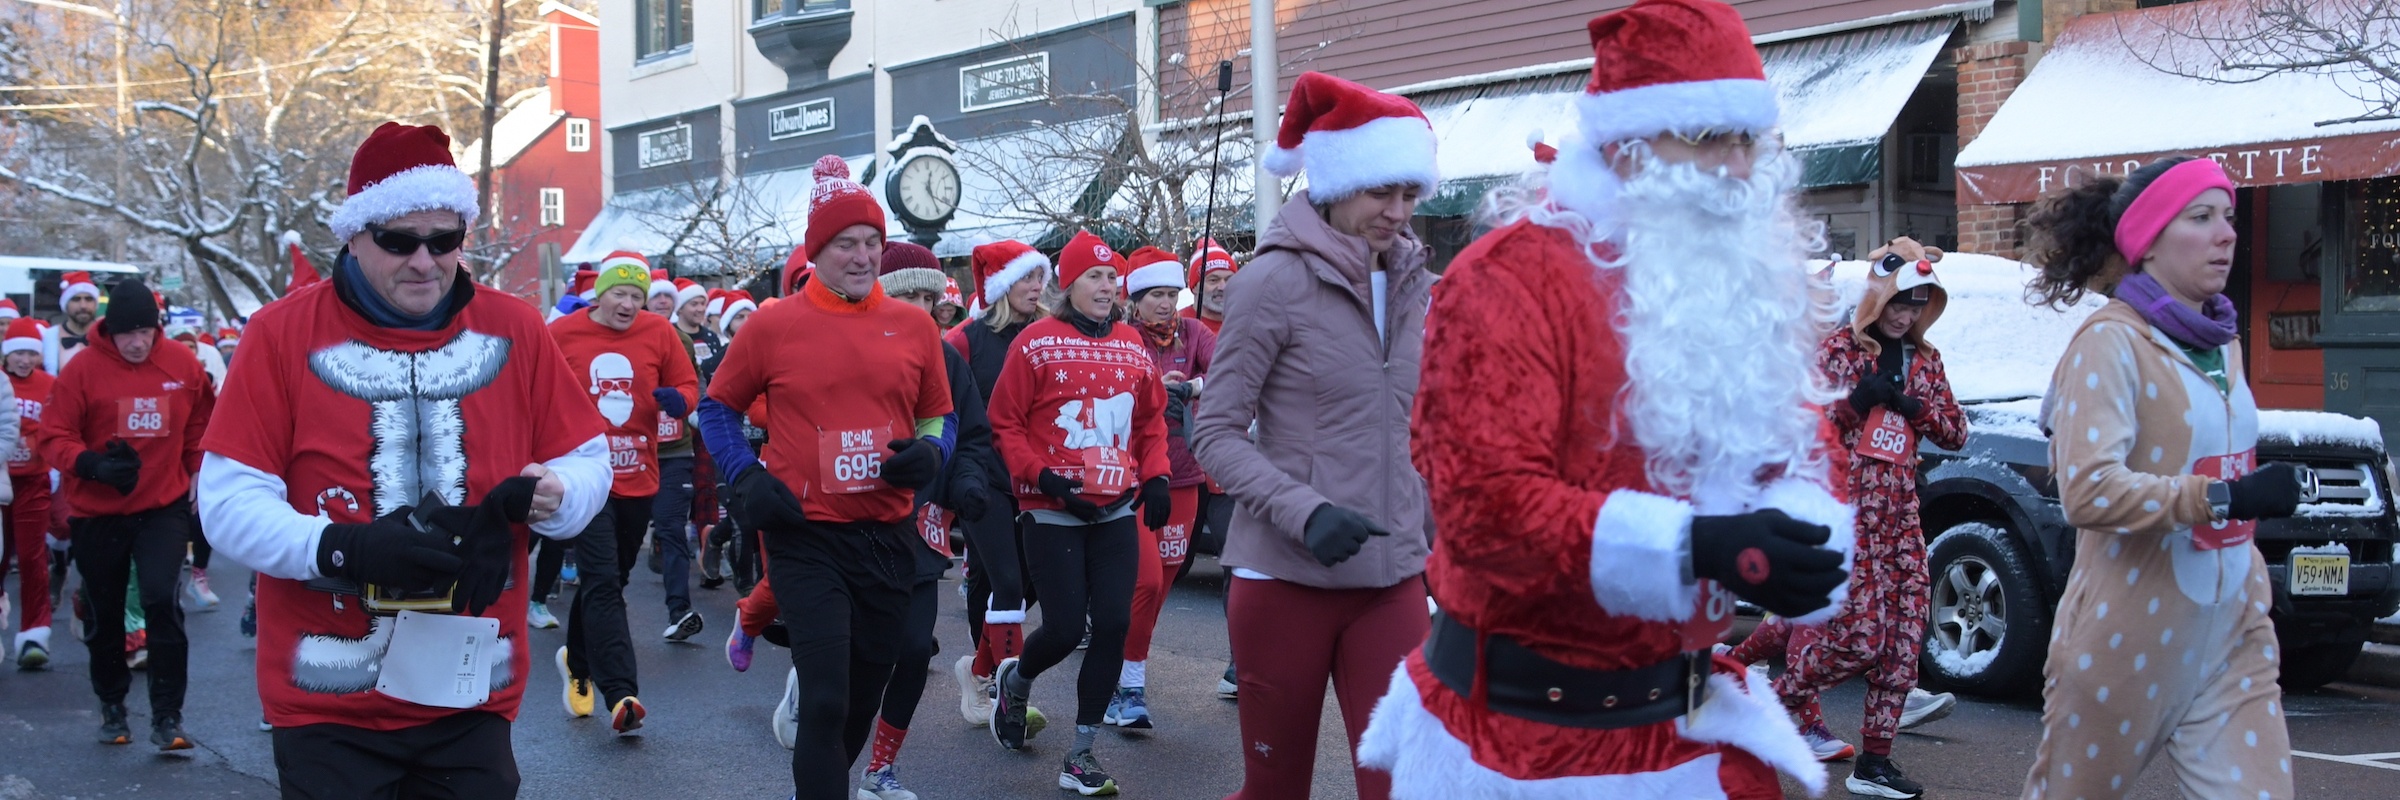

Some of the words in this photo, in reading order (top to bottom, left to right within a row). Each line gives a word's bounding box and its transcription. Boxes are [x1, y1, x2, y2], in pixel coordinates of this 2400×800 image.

[981, 69, 1003, 88] MADE
[1004, 67, 1015, 83] TO
[988, 86, 1014, 100] JEWELRY
[2330, 372, 2349, 390] 36
[128, 413, 162, 430] 648
[657, 422, 678, 436] 861
[1870, 427, 1907, 454] 958
[610, 450, 639, 467] 902
[834, 452, 881, 481] 695
[1096, 465, 1124, 486] 777
[924, 520, 945, 546] 781
[1159, 538, 1187, 558] 950
[2297, 565, 2317, 584] V59
[2323, 565, 2343, 584] NMA
